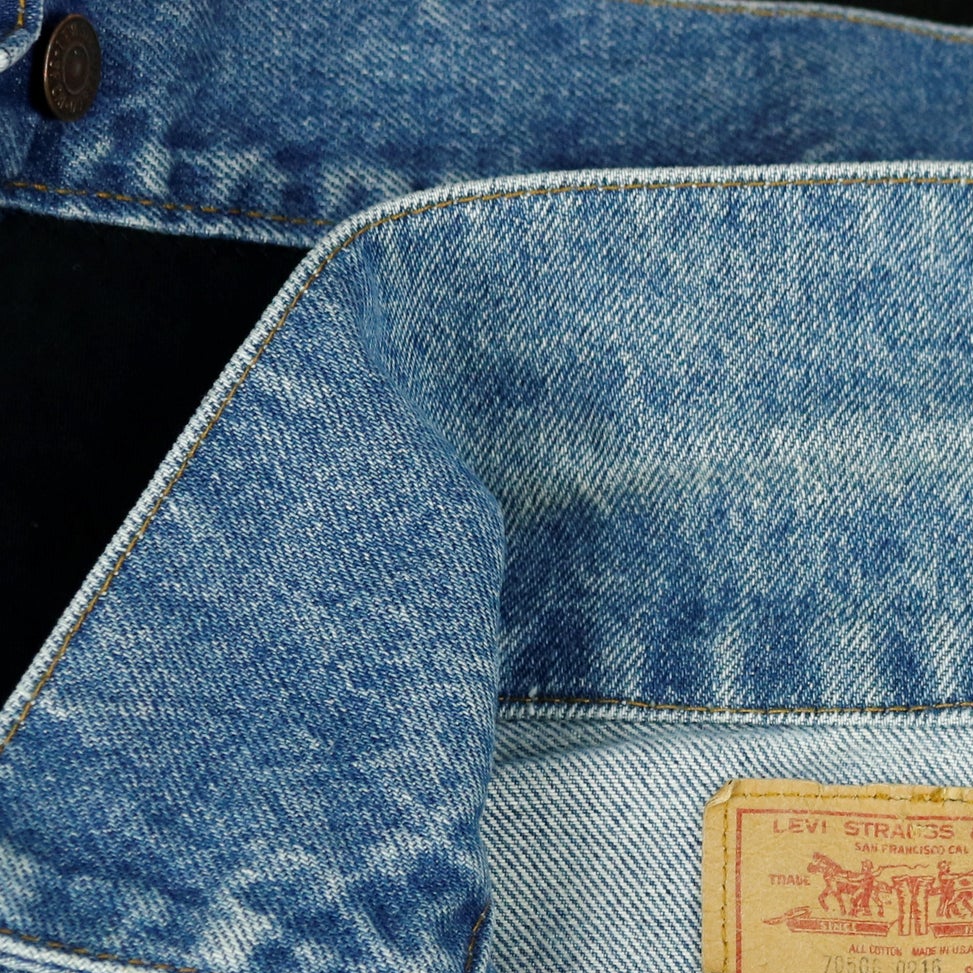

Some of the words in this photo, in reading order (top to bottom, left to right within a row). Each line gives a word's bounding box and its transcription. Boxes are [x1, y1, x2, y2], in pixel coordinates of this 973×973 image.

[773, 818, 827, 834] LEVI
[854, 842, 878, 853] SAN
[767, 873, 811, 887] TRADE
[848, 944, 868, 954] ALL
[869, 945, 903, 957] COTTON
[911, 946, 937, 957] MADE
